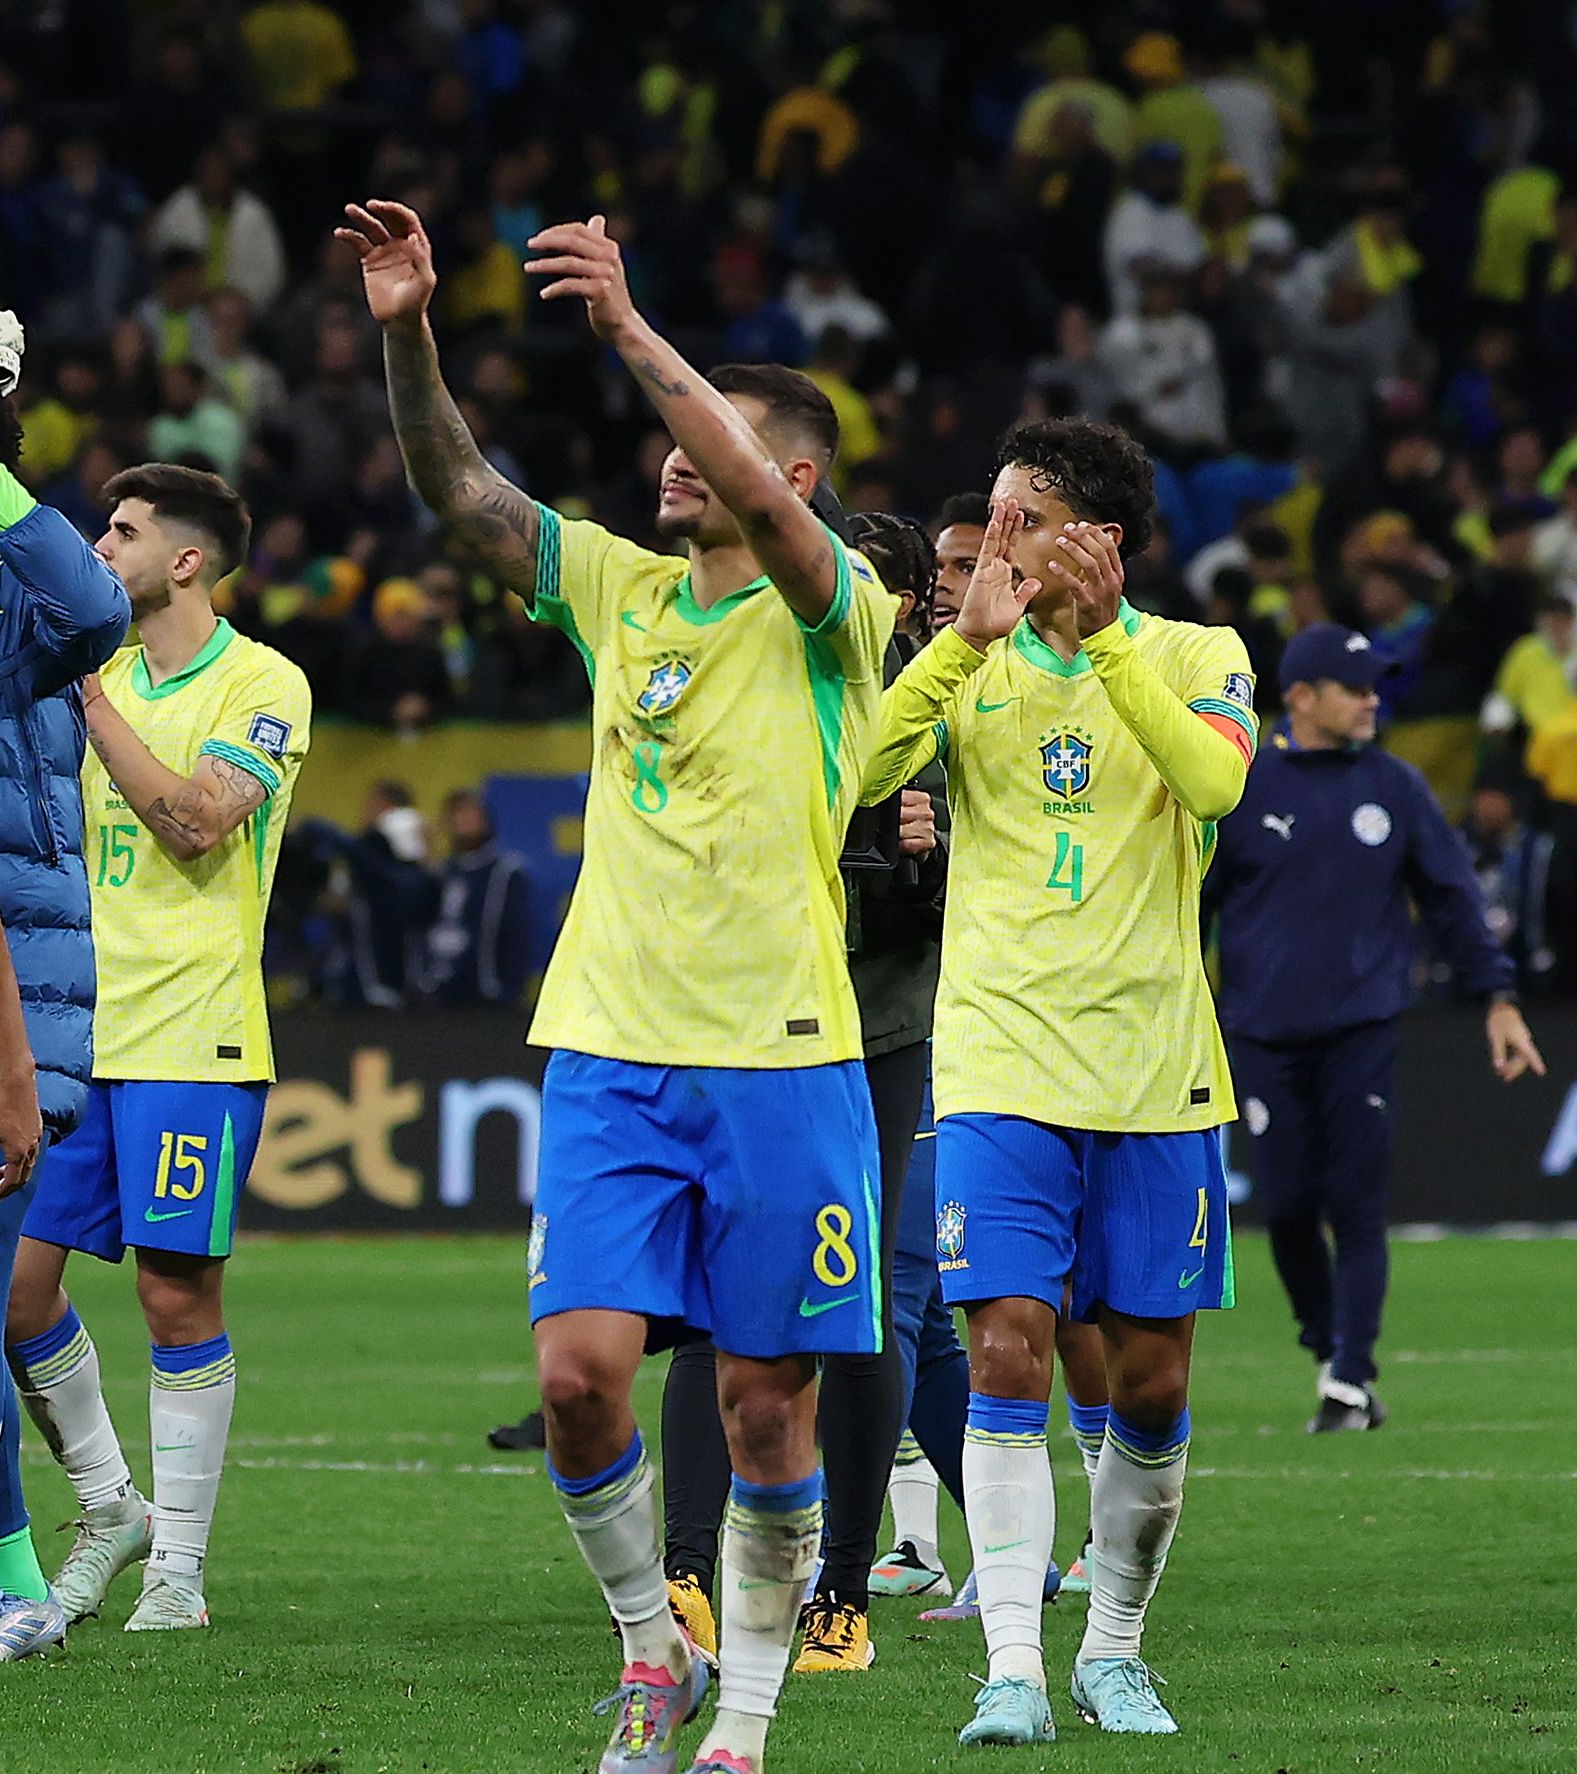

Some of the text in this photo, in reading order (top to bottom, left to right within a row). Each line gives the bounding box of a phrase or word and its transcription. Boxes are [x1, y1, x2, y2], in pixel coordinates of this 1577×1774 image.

[632, 741, 668, 814] 8
[1056, 760, 1076, 769] CBF
[1043, 802, 1095, 815] BRASIL
[96, 825, 138, 888] 15
[1045, 832, 1084, 902] 4
[154, 1131, 208, 1200] 15
[812, 1203, 857, 1287] 8
[1188, 1187, 1209, 1258] 4
[938, 1259, 971, 1273] BRASIL
